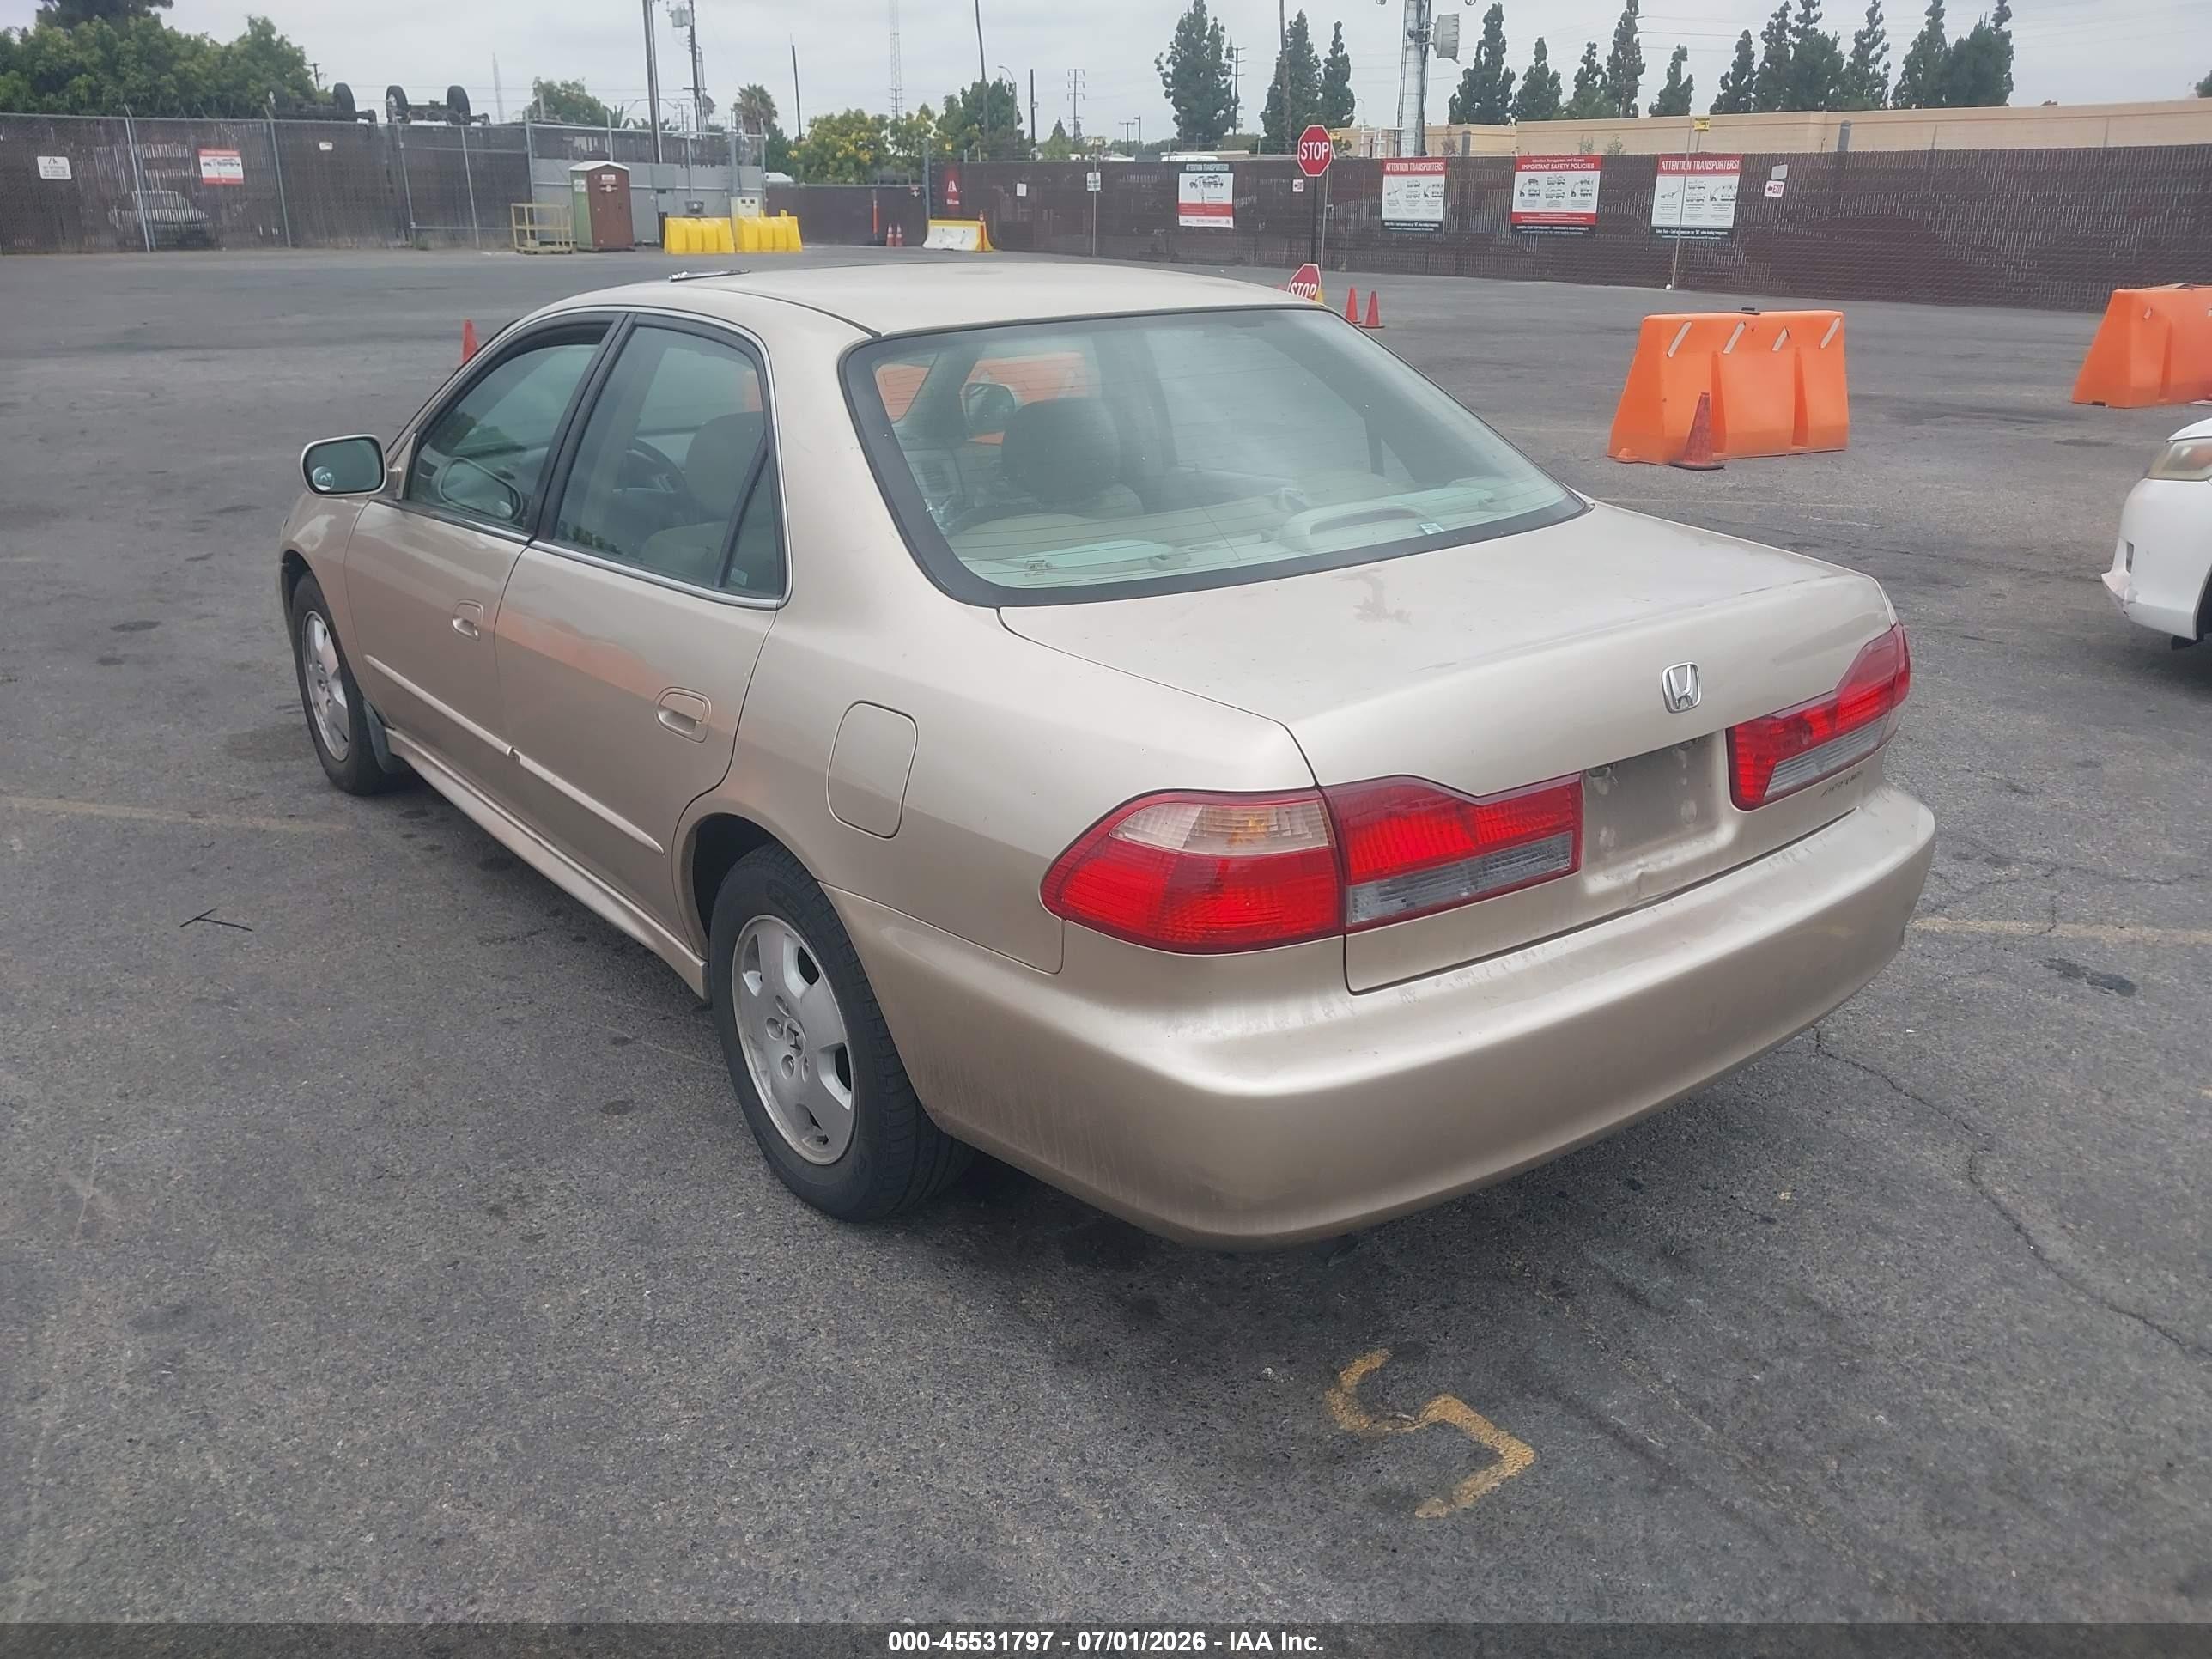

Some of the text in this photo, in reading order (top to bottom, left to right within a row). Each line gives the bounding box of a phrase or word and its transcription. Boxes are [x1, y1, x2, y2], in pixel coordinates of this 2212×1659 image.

[1300, 142, 1329, 161] STOP
[1662, 160, 1692, 171] ATTENTION
[1772, 184, 1784, 194] EXIT
[1291, 281, 1317, 299] STOP
